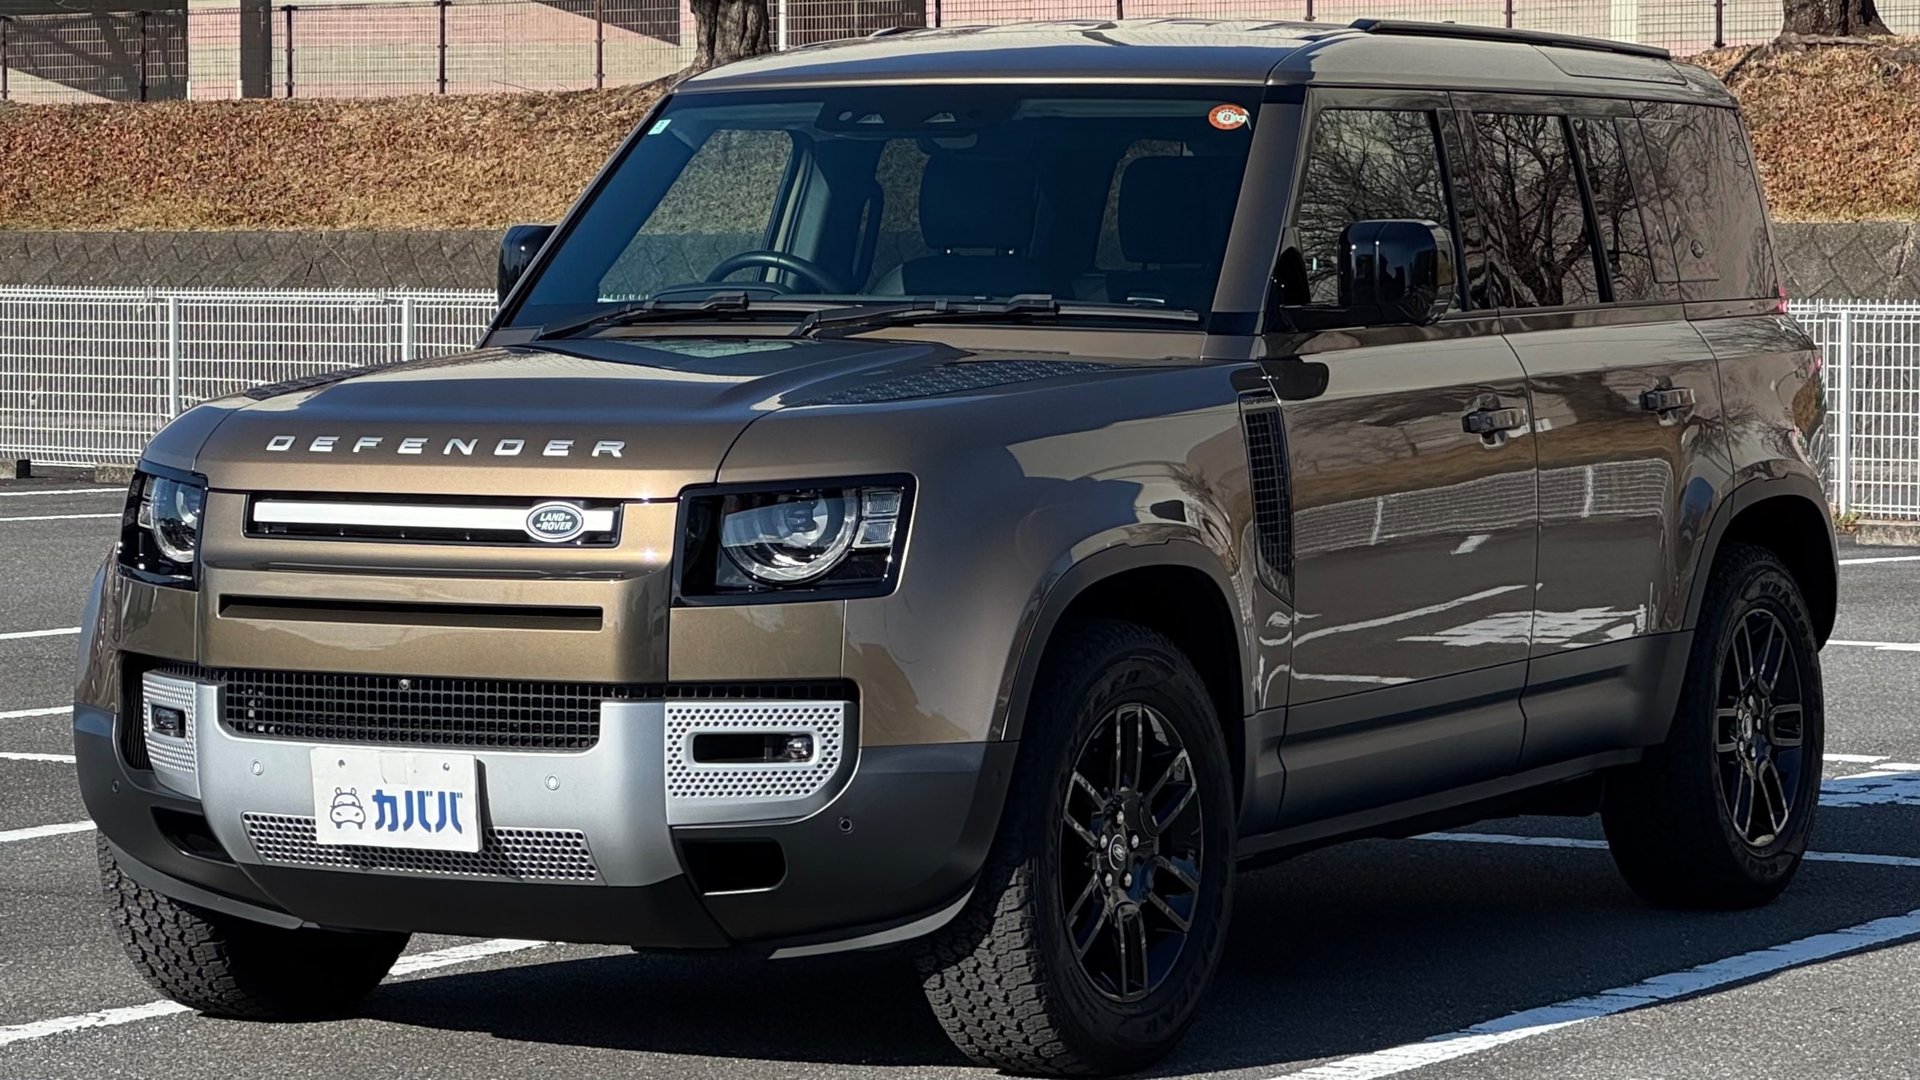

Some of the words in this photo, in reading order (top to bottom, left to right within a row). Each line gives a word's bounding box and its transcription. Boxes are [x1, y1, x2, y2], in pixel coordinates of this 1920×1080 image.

[266, 434, 626, 458] DEFENDER
[540, 512, 566, 521] LAND
[541, 521, 573, 531] ROVER
[371, 788, 464, 835] カババ
